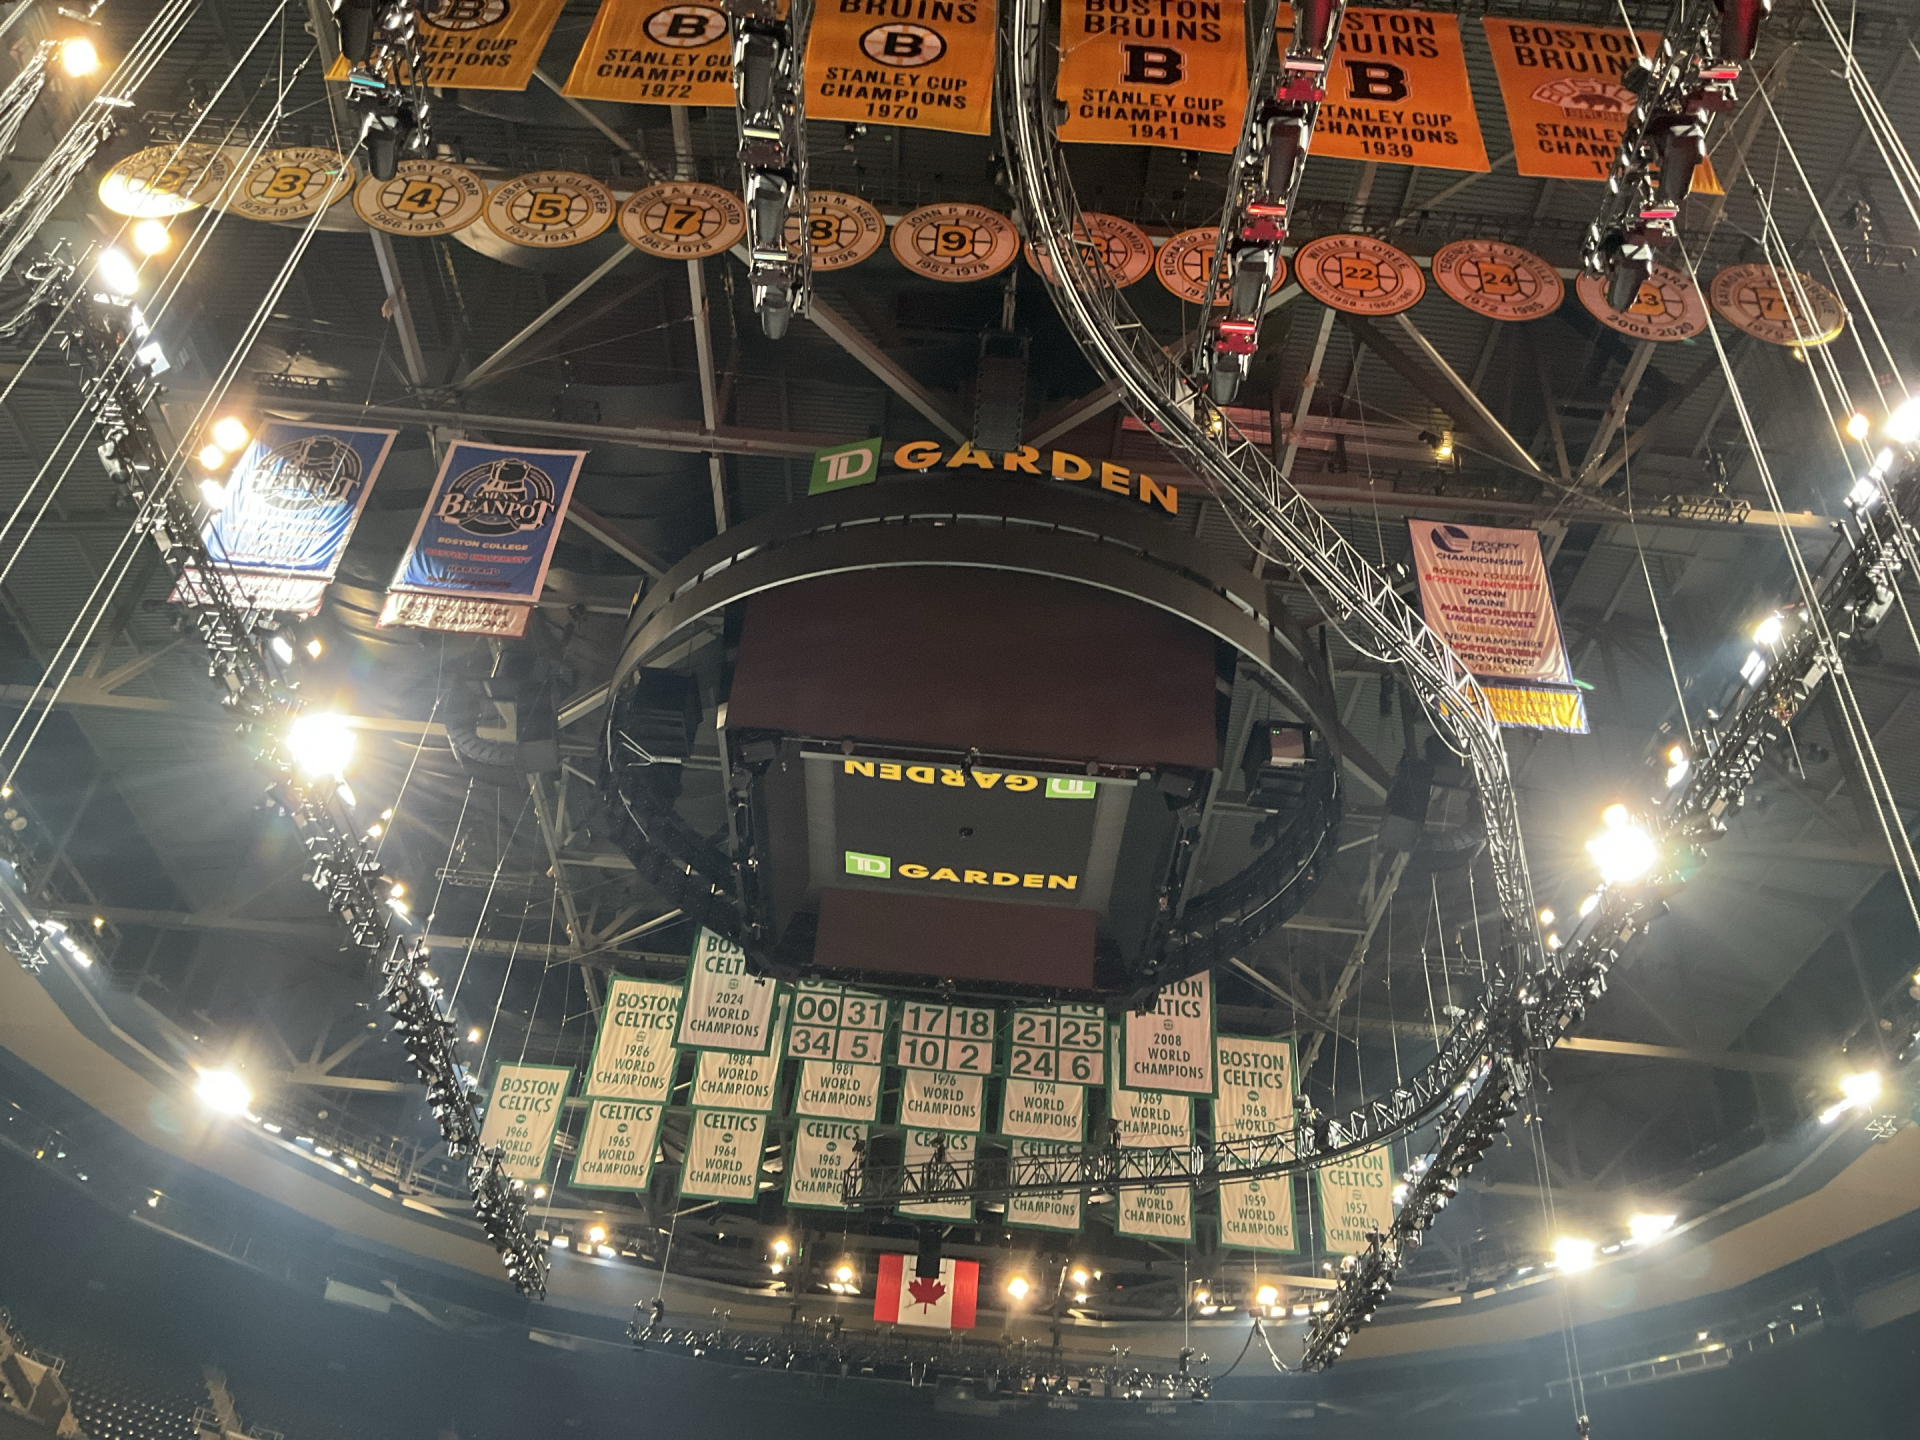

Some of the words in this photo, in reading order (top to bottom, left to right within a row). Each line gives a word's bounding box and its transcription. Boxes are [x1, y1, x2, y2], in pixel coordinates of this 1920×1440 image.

[839, 0, 977, 24] BRUINS
[1085, 0, 1221, 21] BOSTON
[666, 14, 709, 38] B
[1084, 14, 1222, 43] BRUINS
[1346, 14, 1436, 36] STON
[476, 38, 519, 51] CUP
[883, 31, 924, 57] B
[1336, 33, 1439, 58] RUINS
[1508, 24, 1645, 54] BOSTON
[605, 49, 700, 66] STANLEY
[705, 55, 732, 67] CU
[1120, 42, 1186, 86] B
[1515, 46, 1622, 76] BRUIN
[826, 67, 920, 87] STANLEY
[927, 76, 967, 91] CUP
[1341, 58, 1412, 104] B
[641, 83, 693, 99] 1972
[820, 83, 967, 110] CHAMPIONS
[1083, 88, 1176, 108] STANLEY
[1183, 96, 1224, 112] CUP
[866, 103, 918, 120] 1970
[1080, 105, 1226, 128] CHAMPIONS
[1412, 112, 1452, 128] CUP
[1128, 124, 1179, 140] 1941
[1314, 119, 1458, 145] CHAMPIONS
[1360, 140, 1414, 158] 1939
[272, 174, 301, 192] 3
[457, 176, 479, 197] ORR
[406, 188, 433, 208] 4
[494, 176, 540, 207] AUBREY
[566, 177, 608, 214] CLAPPER
[240, 200, 309, 216] 1925-1934
[536, 199, 562, 218] 5
[628, 188, 665, 215] PHILIP
[692, 187, 740, 226] ESPOSITO
[674, 209, 696, 230] 7
[853, 205, 878, 234] NEELY
[906, 209, 942, 229] JOHN
[966, 209, 1008, 234] BUCYK
[505, 225, 578, 243] 1927-1947
[810, 219, 833, 240] 8
[1099, 218, 1146, 255] SCHMIDT
[942, 230, 967, 251] 9
[1306, 240, 1349, 260] WILLIE
[1345, 266, 1374, 280] 22
[1483, 272, 1513, 287] 24
[819, 447, 873, 483] TD
[894, 440, 1179, 515] GARDEN
[483, 491, 519, 501] MEN'S
[434, 491, 555, 527] BEANPOT
[437, 536, 480, 548] BOSTON
[482, 542, 529, 551] COLLEGE
[1471, 546, 1499, 554] EAST
[1472, 540, 1519, 549] HOCKEY
[1436, 552, 1524, 566] CHAMPIONSHIP
[1432, 566, 1479, 578] BOSTON
[1425, 573, 1472, 586] BOSTON
[1476, 580, 1540, 591] UNIVERSITY
[1462, 588, 1507, 598] UCONN
[1468, 598, 1505, 608] MAINE
[1446, 613, 1487, 624] UMASS
[1490, 618, 1535, 629] LOWELL
[1444, 632, 1472, 641] NEW
[1475, 636, 1544, 649] HAMPSHIRE
[1460, 652, 1535, 667] PROVIDENCE
[844, 760, 1039, 791] GARDEN
[849, 855, 887, 873] TD
[898, 863, 1078, 889] GARDEN
[705, 956, 746, 976] CELT
[616, 993, 678, 1012] BOSTON
[716, 992, 744, 1005] 2024
[707, 1006, 750, 1021] WORLD
[797, 996, 837, 1022] 00
[847, 1001, 882, 1026] 31
[614, 1011, 675, 1030] CELTICS
[690, 1019, 760, 1037] CHAMPIONS
[908, 1006, 944, 1032] 17
[956, 1010, 989, 1036] 18
[1016, 1016, 1052, 1043] 21
[1062, 1020, 1102, 1047] 25
[792, 1029, 830, 1055] 34
[850, 1035, 869, 1059] 5
[1154, 1033, 1182, 1046] 2008
[625, 1044, 650, 1058] 1986
[728, 1053, 753, 1067] 1984
[905, 1038, 939, 1066] 10
[959, 1044, 979, 1070] 2
[1148, 1047, 1191, 1062] WORLD
[1220, 1049, 1285, 1071] BOSTON
[615, 1058, 655, 1073] WORLD
[831, 1063, 853, 1076] 1981
[1012, 1049, 1053, 1077] 24
[1071, 1055, 1091, 1080] 6
[1134, 1062, 1204, 1079] CHAMPIONS
[596, 1071, 665, 1089] CHAMPIONS
[718, 1067, 758, 1081] WORLD
[933, 1072, 957, 1087] 1976
[1223, 1069, 1283, 1089] CELTICS
[500, 1077, 560, 1096] BOSTON
[701, 1080, 769, 1097] CHAMPIONS
[820, 1076, 860, 1091] WORLD
[1033, 1083, 1056, 1096] 1974
[804, 1090, 872, 1107] CHAMPIONS
[923, 1086, 964, 1101] WORLD
[1138, 1092, 1163, 1106] 1969
[498, 1094, 553, 1113] CELTICS
[599, 1104, 653, 1121] CELTICS
[908, 1100, 976, 1118] CHAMPIONS
[1024, 1096, 1065, 1112] WORLD
[1241, 1103, 1267, 1117] 1968
[703, 1112, 758, 1132] CELTICS
[1009, 1109, 1077, 1128] CHAMPIONS
[1130, 1106, 1171, 1121] WORLD
[505, 1126, 529, 1138] 1966
[806, 1122, 860, 1141] CELTICS
[1118, 1119, 1185, 1138] CHAMPIONS
[1234, 1117, 1276, 1133] WORLD
[496, 1139, 533, 1153] WORLD
[608, 1135, 631, 1147] 1965
[1020, 1141, 1075, 1158] CELTICS
[598, 1148, 635, 1161] WORLD
[714, 1145, 737, 1158] 1964
[818, 1154, 841, 1166] 1963
[582, 1161, 645, 1177] CHAMPIONS
[705, 1158, 743, 1172] WORLD
[689, 1170, 753, 1187] CHAMPIONS
[1328, 1169, 1384, 1188] CELTICS
[1013, 1199, 1075, 1216] CHAMPIONS
[1136, 1197, 1173, 1211] WORLD
[1243, 1194, 1267, 1207] 1959
[1345, 1202, 1368, 1214] 1957
[1124, 1209, 1186, 1227] CHAMPIONS
[1238, 1207, 1276, 1222] WORLD
[1341, 1216, 1379, 1228] WORLD
[1226, 1220, 1289, 1237] CHAMPIONS
